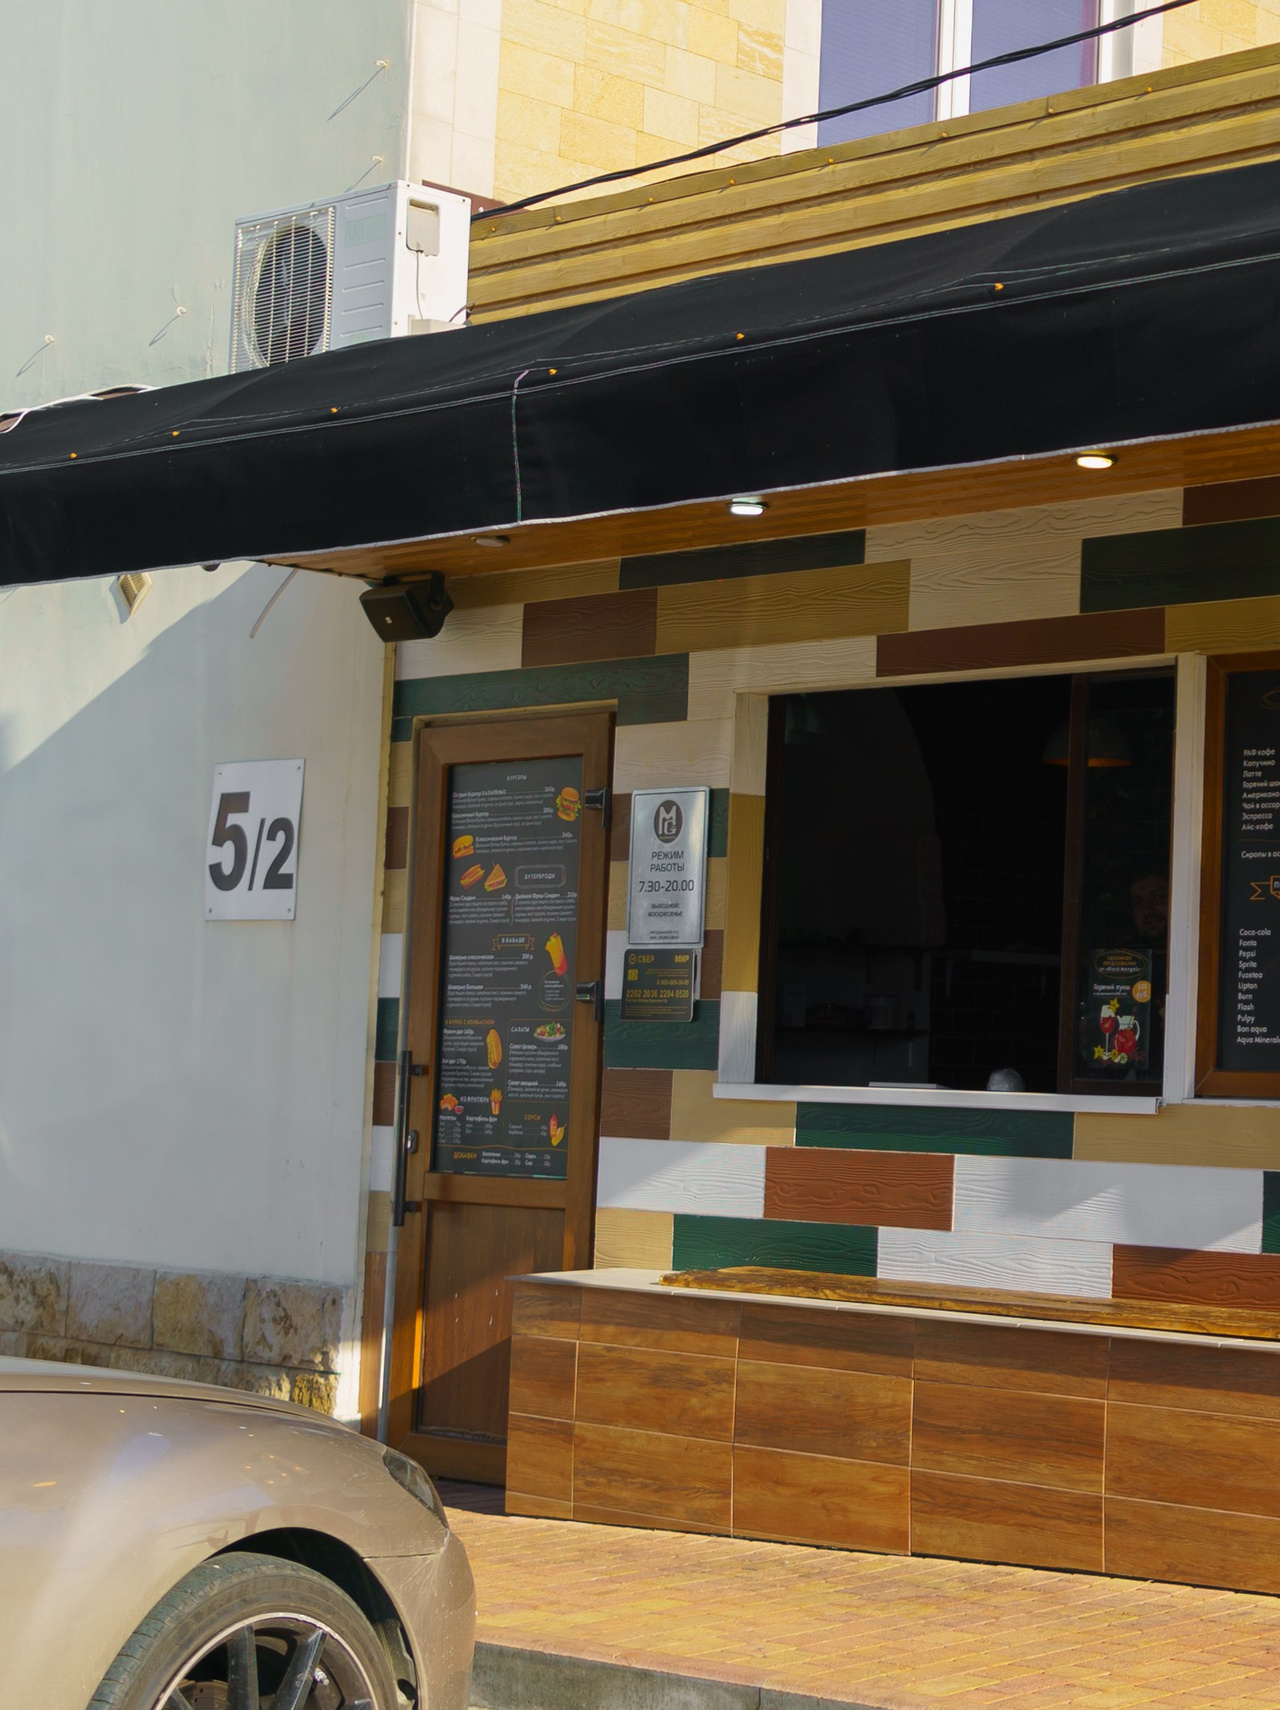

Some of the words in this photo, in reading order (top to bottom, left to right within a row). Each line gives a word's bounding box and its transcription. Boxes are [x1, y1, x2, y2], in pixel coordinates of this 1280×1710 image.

[208, 791, 295, 891] 5/2
[652, 851, 684, 860] РЕЖИМ
[650, 863, 684, 872] РАБОТЫ
[639, 880, 694, 892] 7.30-20.00
[637, 955, 655, 963] СБЕР
[674, 955, 689, 963] МИР
[1239, 950, 1256, 959] Pepsi
[1239, 960, 1257, 969] Sprite
[1238, 982, 1258, 991] Lipton
[1237, 1014, 1255, 1024] Pulpy
[1236, 1036, 1254, 1045] Aqua
